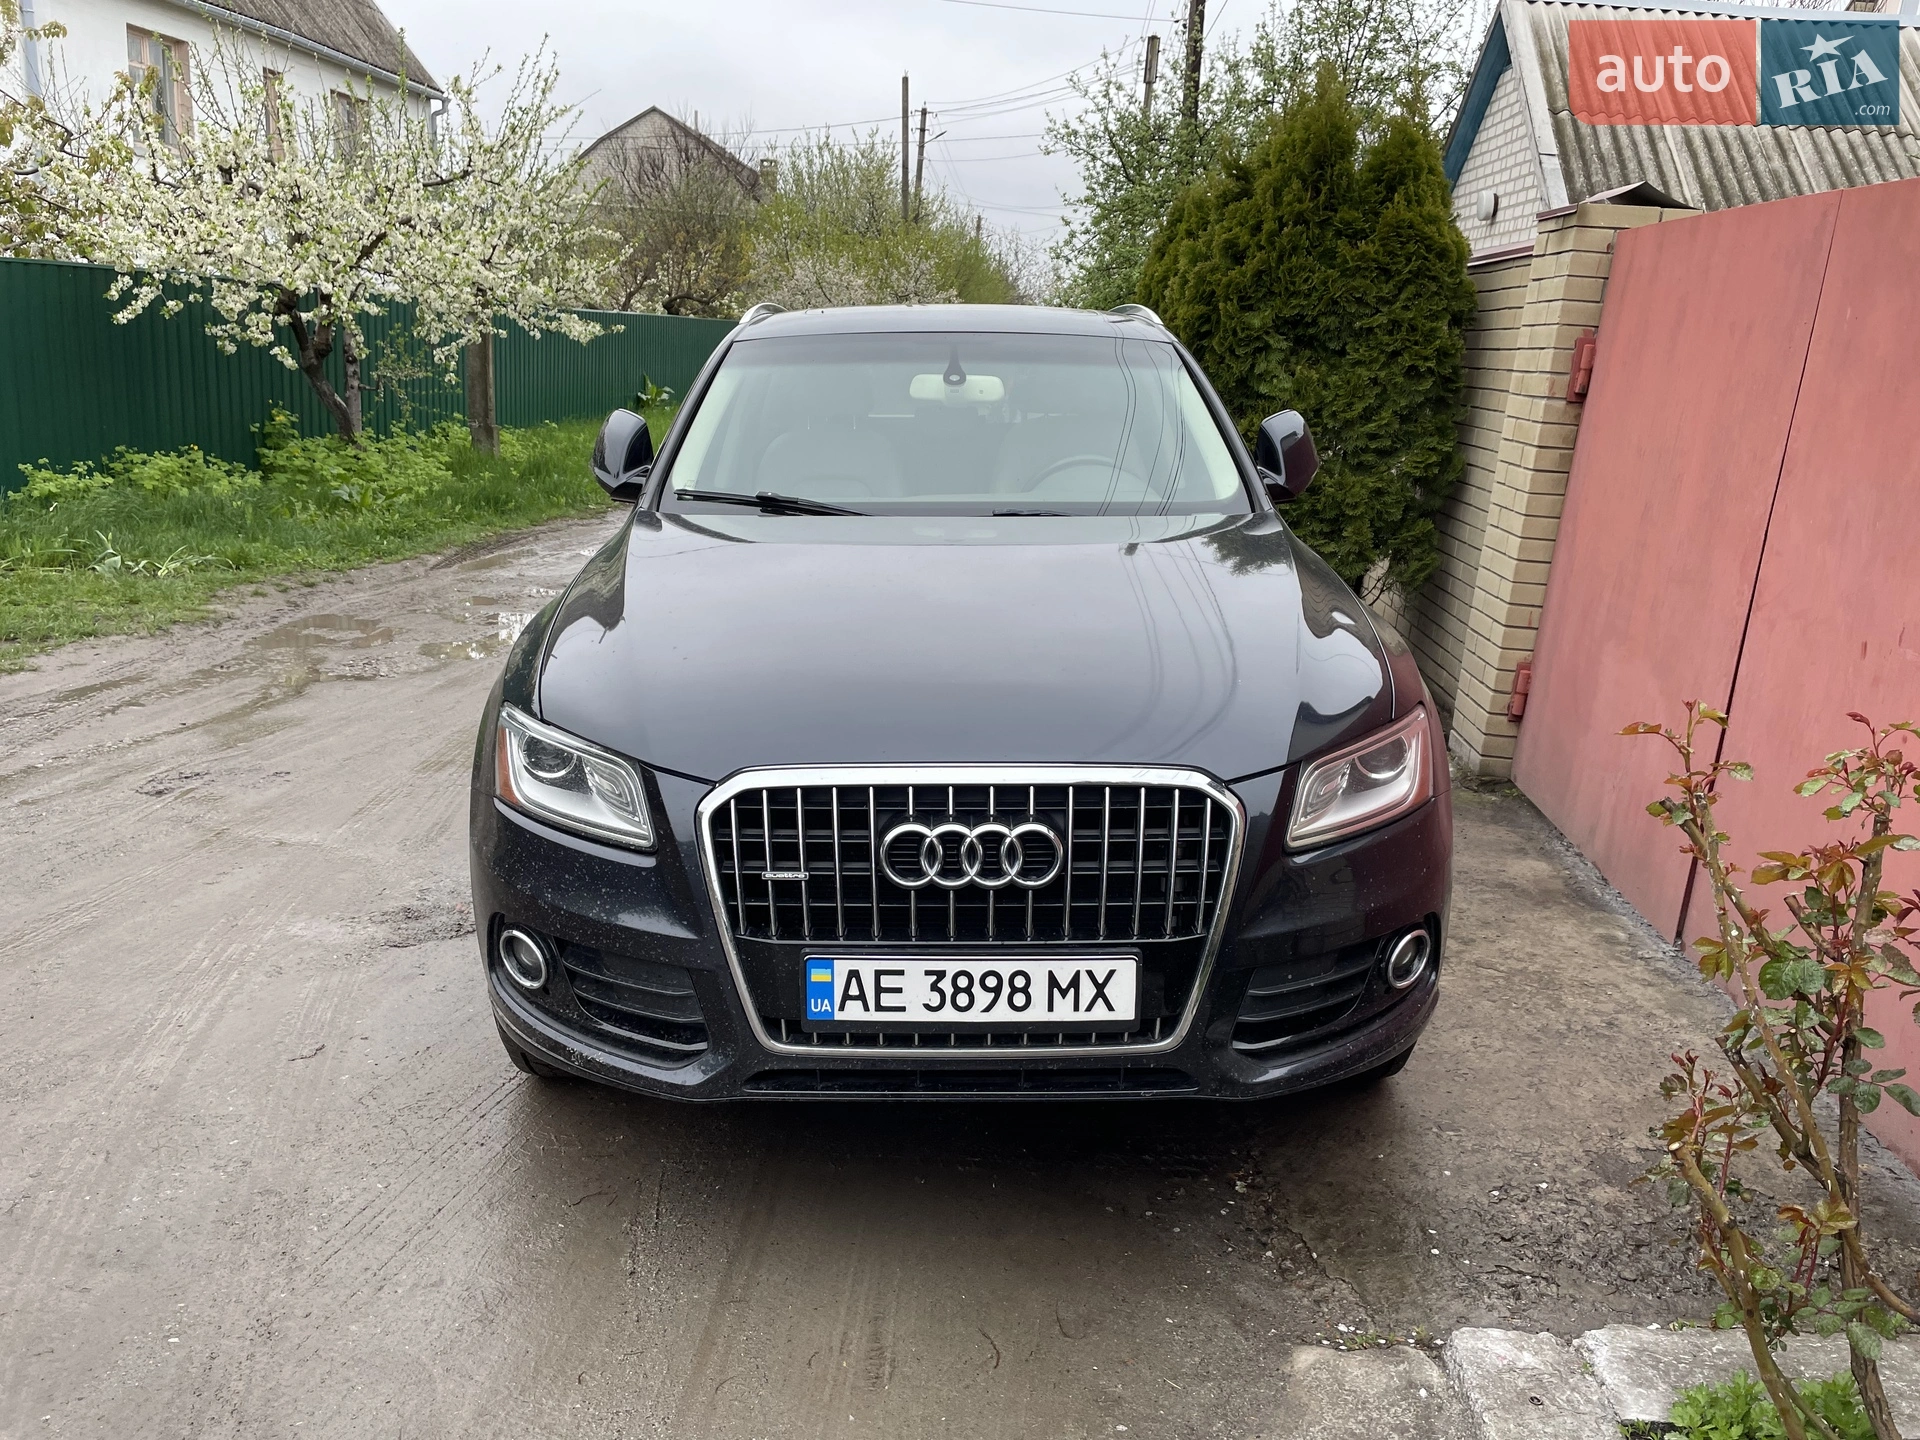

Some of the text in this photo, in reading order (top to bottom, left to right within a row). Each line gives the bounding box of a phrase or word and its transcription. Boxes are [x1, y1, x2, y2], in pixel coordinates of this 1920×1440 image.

[838, 969, 1117, 1012] AE 3898 MX
[811, 998, 832, 1012] UA
